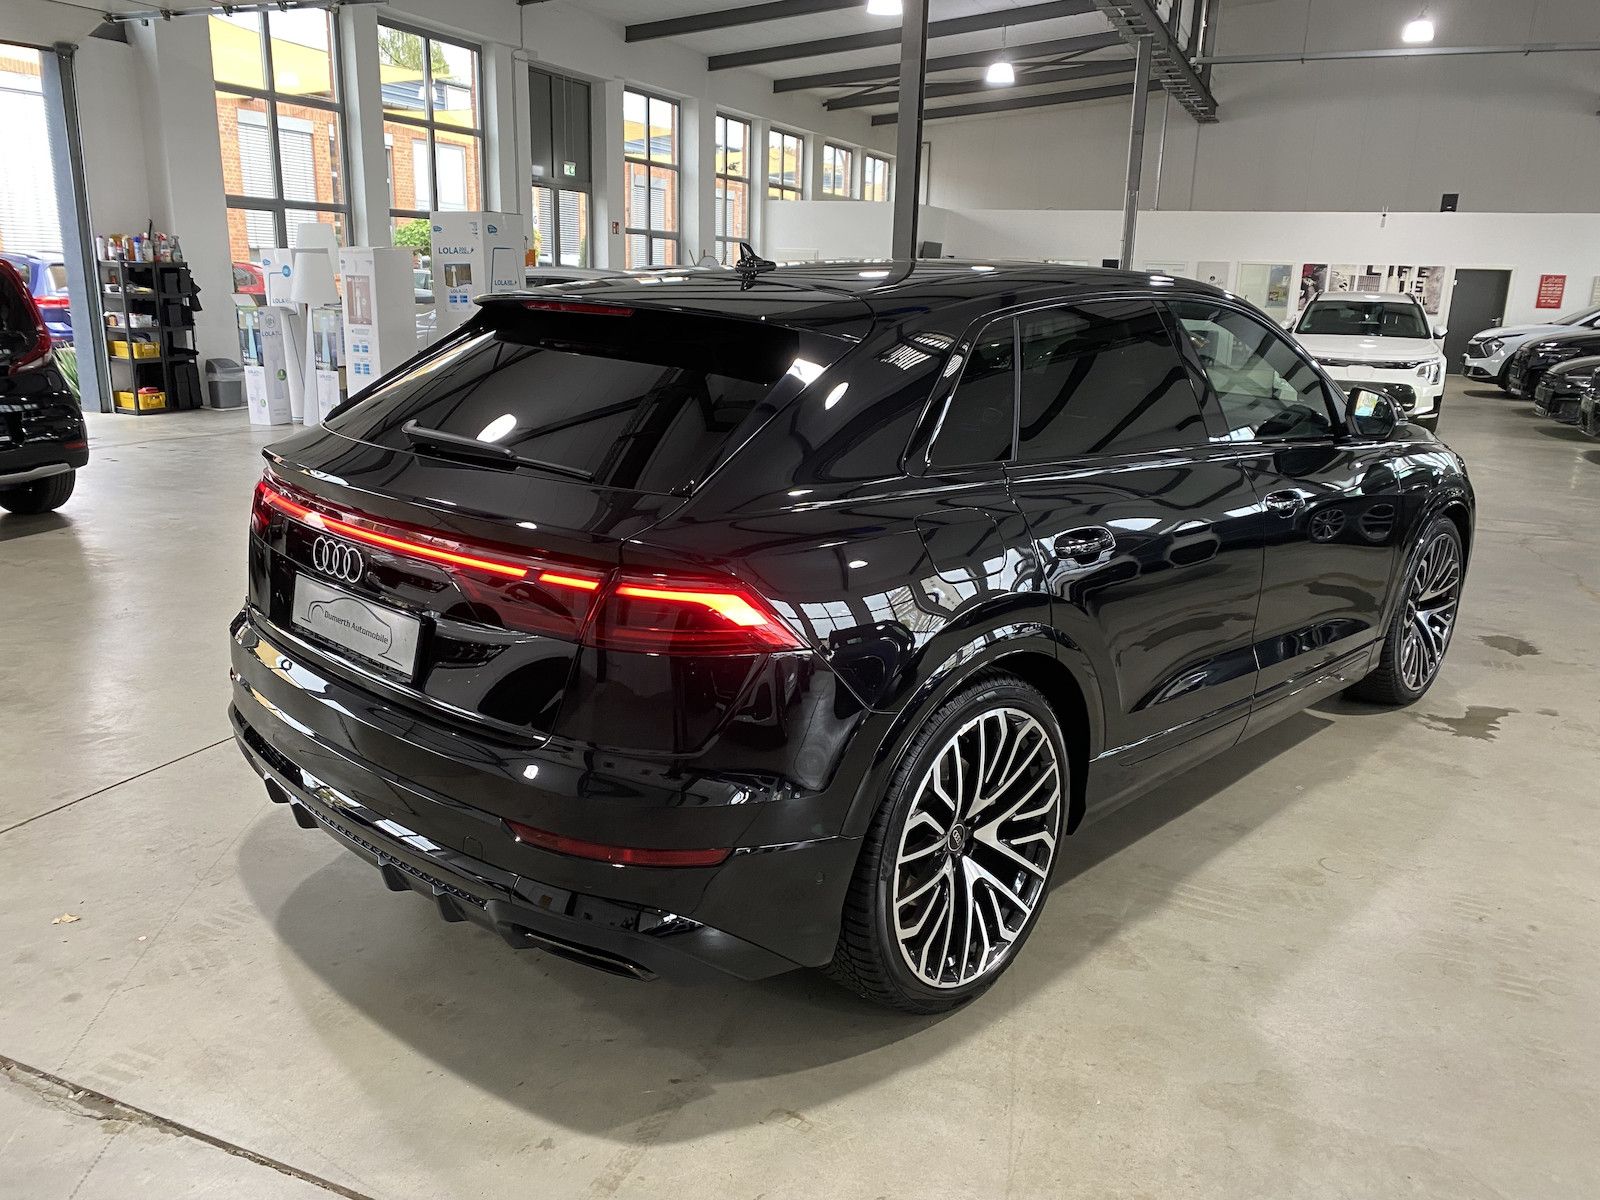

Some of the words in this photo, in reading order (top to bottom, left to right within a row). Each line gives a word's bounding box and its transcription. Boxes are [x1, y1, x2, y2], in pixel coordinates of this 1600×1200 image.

[438, 247, 459, 255] LOLA
[1366, 265, 1430, 278] LIFE
[324, 610, 351, 628] Dumerth
[351, 622, 389, 645] Automobile
